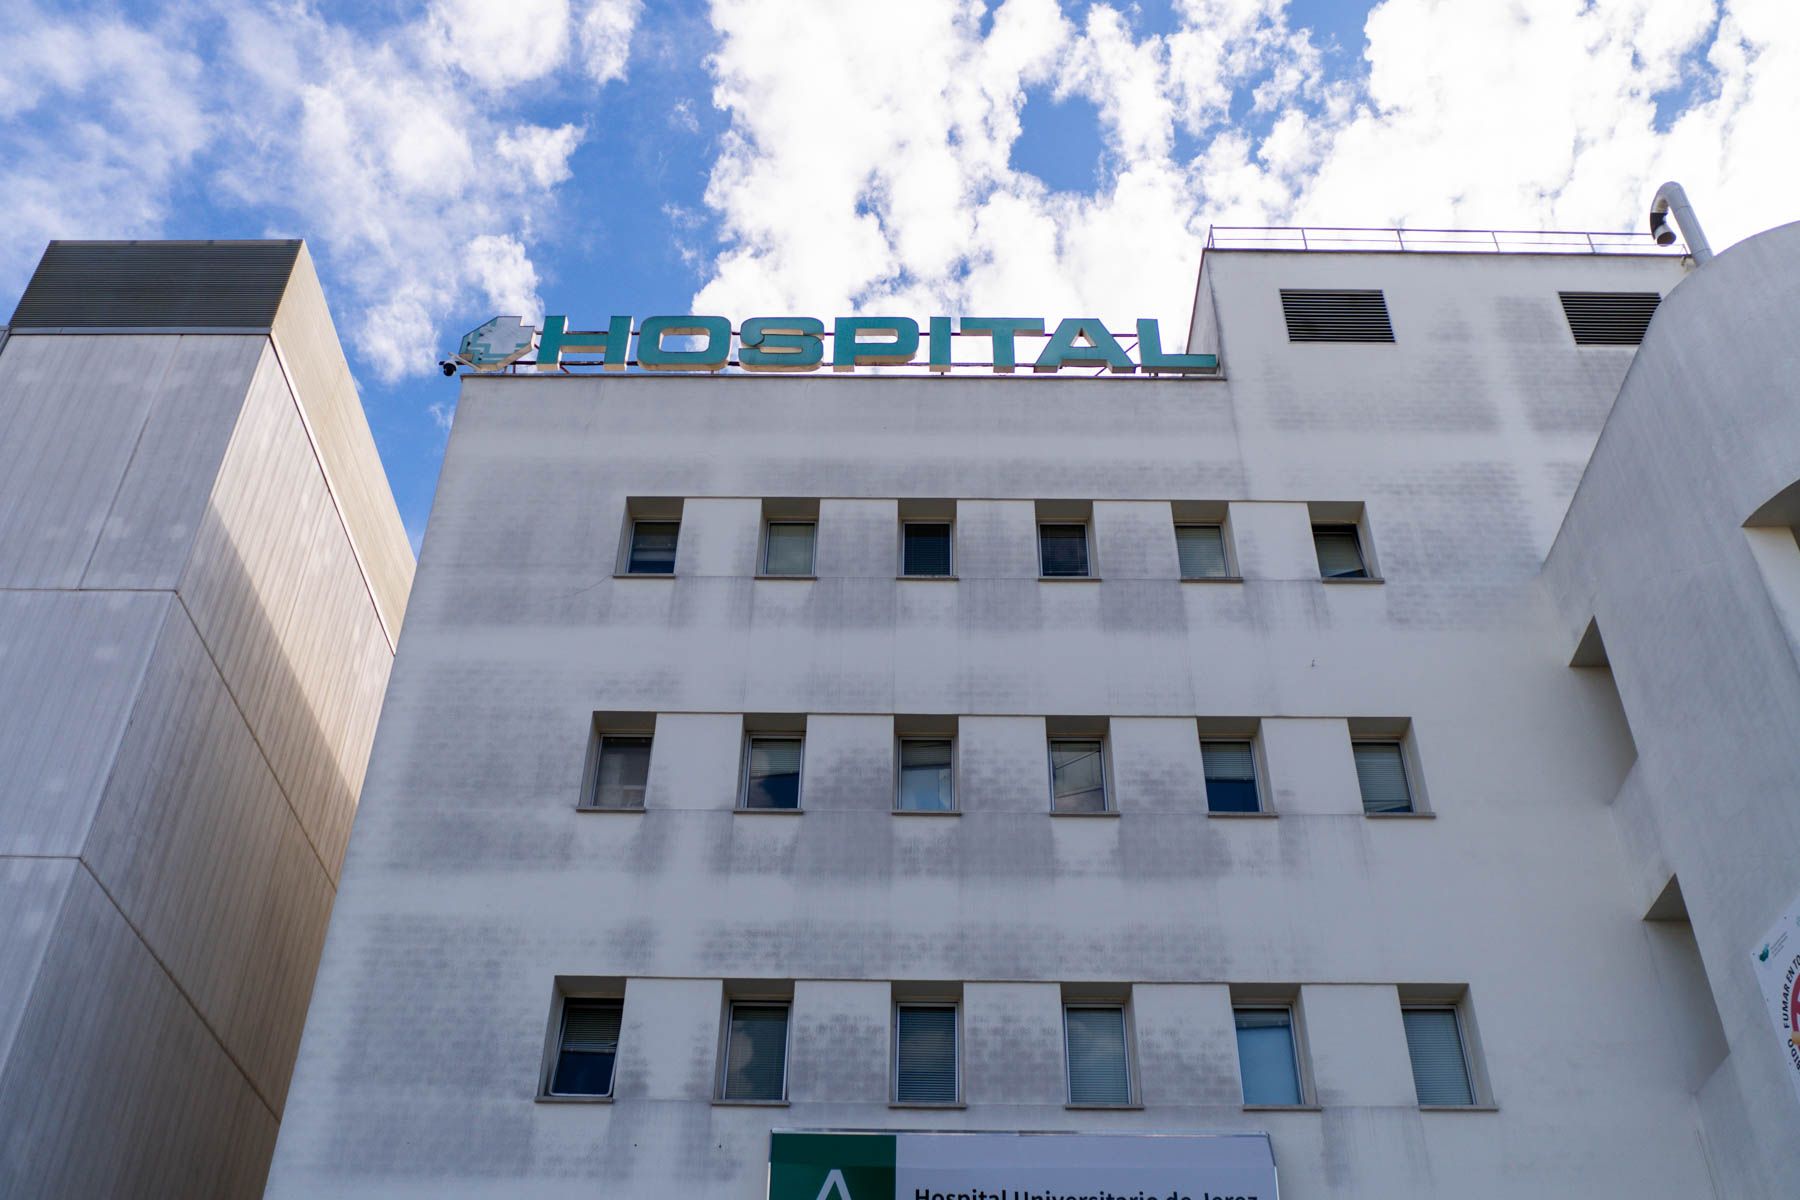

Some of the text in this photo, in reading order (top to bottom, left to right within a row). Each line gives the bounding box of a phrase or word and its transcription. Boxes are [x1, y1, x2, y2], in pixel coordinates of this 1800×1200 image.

[537, 316, 1217, 374] HOSPITAL
[1782, 984, 1790, 1029] FUMAR
[1786, 966, 1795, 983] EN
